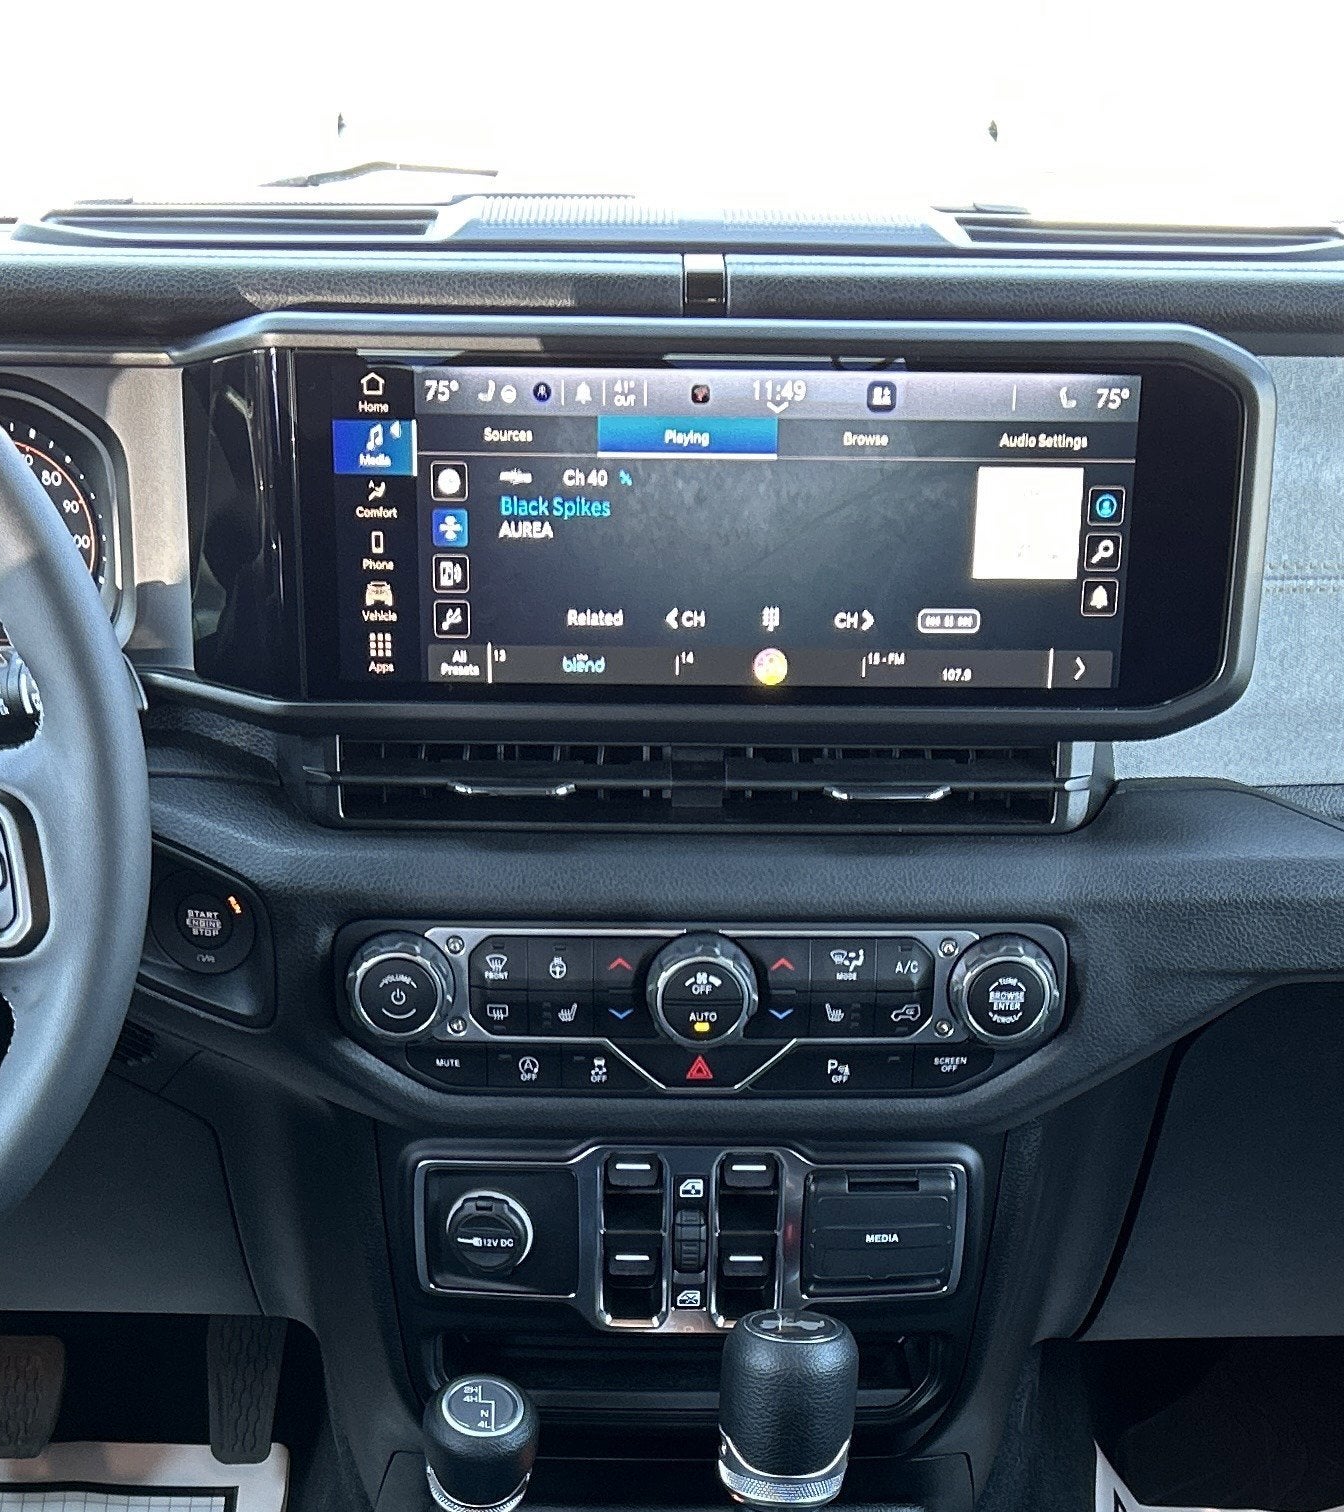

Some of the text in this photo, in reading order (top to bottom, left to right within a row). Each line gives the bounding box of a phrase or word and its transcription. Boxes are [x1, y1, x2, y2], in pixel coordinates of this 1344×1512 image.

[753, 379, 807, 401] 11:49
[358, 400, 389, 413] Home
[614, 394, 636, 407] OUT
[483, 427, 533, 442] Sources
[664, 429, 710, 447] Playing
[843, 431, 889, 447] Browse
[999, 433, 1088, 450] Audio Settings
[359, 453, 392, 467] Media
[41, 470, 62, 486] 80
[563, 468, 608, 487] Ch 40
[63, 500, 79, 514] 90
[356, 506, 398, 518] Comfort
[501, 495, 611, 520] Black Spikes
[498, 520, 554, 539] AUREA
[73, 534, 90, 549] 00
[362, 558, 394, 571] Phone
[362, 609, 398, 622] Vehicle
[567, 608, 624, 627] Related
[681, 610, 706, 628] CH
[833, 612, 858, 630] CH
[452, 650, 467, 663] All
[681, 651, 694, 664] 14
[887, 652, 905, 665] FM
[368, 660, 394, 674] Apps
[440, 662, 480, 676] Presets
[562, 656, 606, 673] blend
[187, 909, 219, 919] START
[186, 918, 222, 929] ENGINE
[192, 927, 219, 937] STOP
[895, 961, 918, 974] A/C
[383, 974, 412, 985] VOLUME
[484, 972, 508, 980] FRONT
[836, 973, 857, 981] MODE
[692, 984, 712, 996] OFF
[989, 991, 1025, 1001] BROWSE
[993, 1001, 1021, 1011] ENTER
[689, 1011, 717, 1022] AUTO
[436, 1058, 461, 1068] MUTE
[934, 1056, 967, 1066] SCREEN
[941, 1064, 957, 1072] OFF
[521, 1074, 538, 1082] OFF
[590, 1074, 607, 1083] OFF
[831, 1075, 848, 1084] OFF
[483, 1238, 514, 1248] 12V DC
[865, 1233, 900, 1244] MEDIA
[480, 1410, 489, 1418] N
[478, 1421, 491, 1429] 4L
